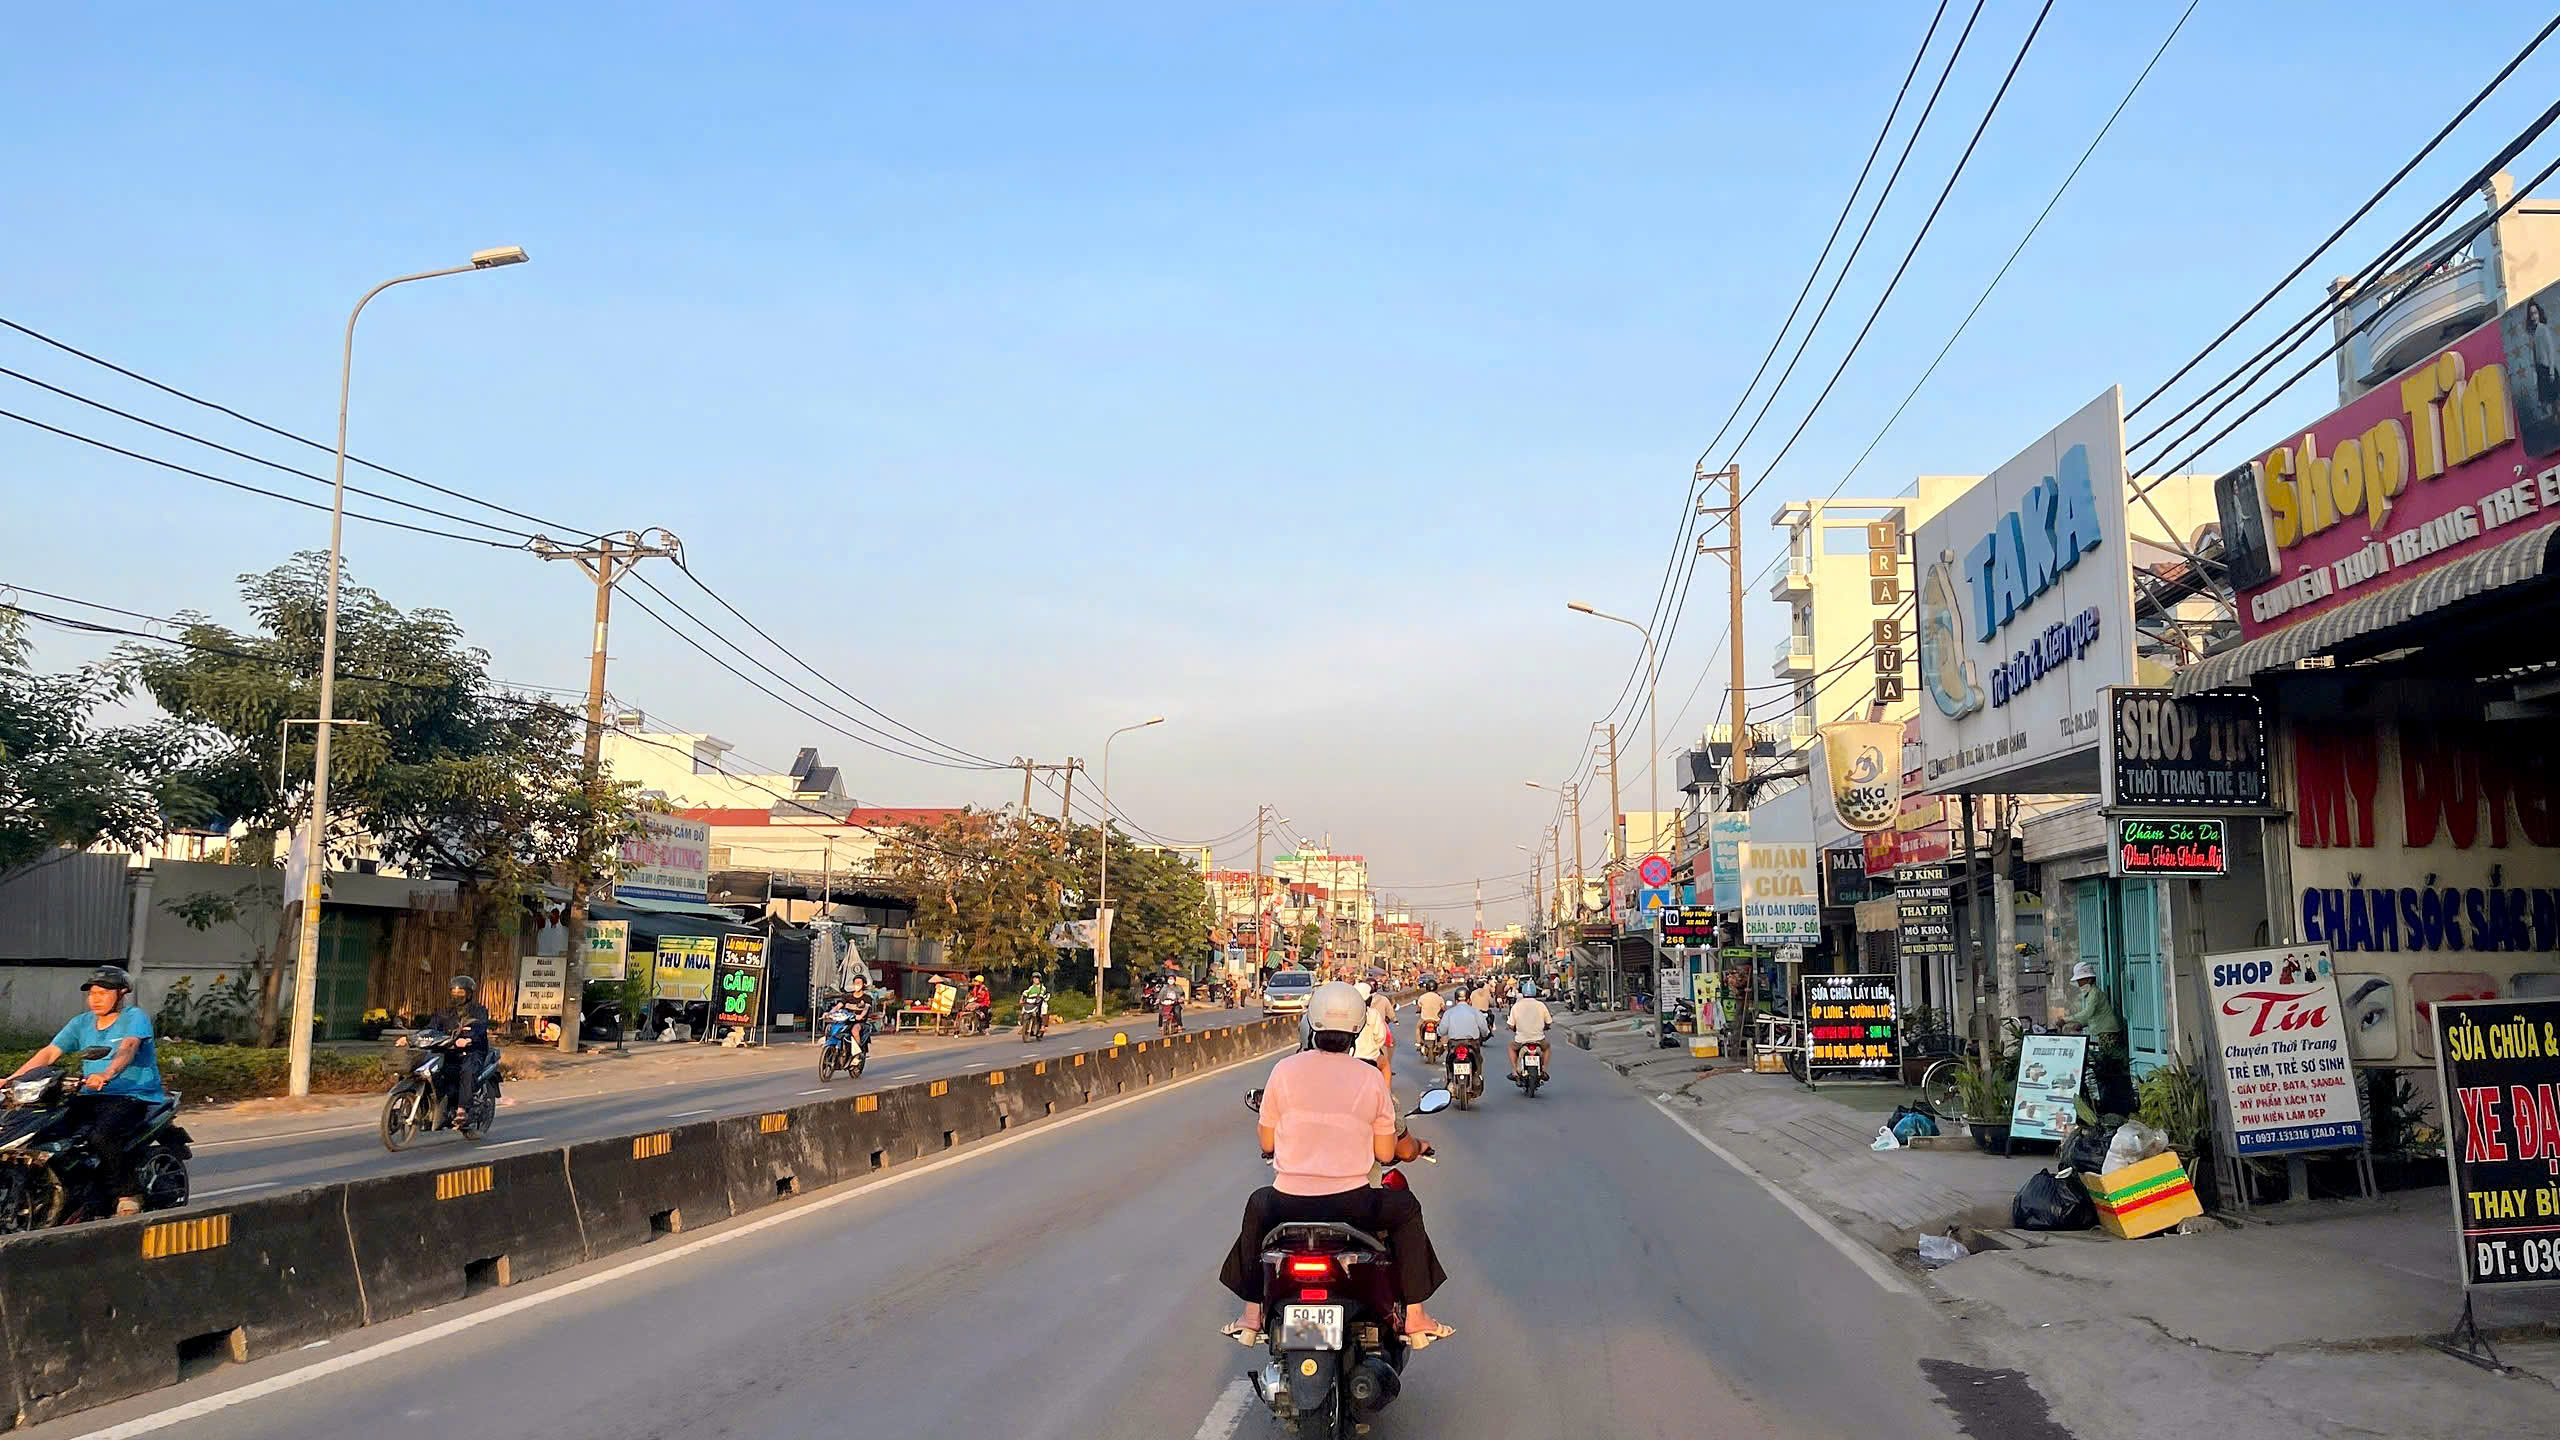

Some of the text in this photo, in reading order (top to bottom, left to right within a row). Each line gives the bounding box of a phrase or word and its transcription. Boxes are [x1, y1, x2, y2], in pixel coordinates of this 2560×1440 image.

[2264, 351, 2515, 548] Shop Tin
[2387, 505, 2481, 567] TRANG
[2477, 464, 2540, 530] TRẺ
[2537, 463, 2560, 508] E
[1964, 443, 2103, 643] TAKA
[1878, 526, 1898, 698] TRÀ SỮA
[2070, 606, 2100, 662] que
[2121, 699, 2199, 761] SHOP
[2127, 761, 2259, 796] THỜI TRANG TRẺ EM
[2125, 822, 2219, 842] Chăm Sóc Da
[1756, 869, 1805, 897] CỬA
[1901, 905, 1948, 917] THAY PIN
[2302, 872, 2398, 952] CHĂM
[2400, 872, 2465, 952] SÓC
[2467, 863, 2530, 952] SẮC
[1666, 936, 1685, 944] 268
[659, 952, 682, 968] THU
[684, 953, 711, 970] MUA
[724, 950, 739, 964] 3%
[745, 952, 760, 966] 5%
[723, 969, 756, 993] CẦM
[2213, 960, 2273, 988] SHOP
[724, 992, 748, 1014] ĐỒ
[1811, 983, 1828, 1000] SỬA
[1830, 984, 1852, 1000] CHỮA
[1853, 982, 1869, 1000] LẤY
[1811, 1002, 1822, 1019] ỐP
[1849, 1002, 1876, 1019] CƯỜNG
[1876, 1003, 1891, 1020] LỰC
[2222, 986, 2331, 1037] Tin
[2225, 1038, 2338, 1059] Chuyên Thời Trang
[2448, 1012, 2560, 1062] SỬA CHỮA &
[2228, 1057, 2345, 1080] TRẺ EM, TRẺ SƠ SINH
[2311, 1076, 2345, 1089] SANDAL
[2256, 1093, 2282, 1109] PHẨM
[2310, 1093, 2328, 1104] TAY
[2242, 1113, 2261, 1125] PHỤ
[2457, 1083, 2560, 1175] XE ĐẠ
[2468, 1188, 2528, 1220] THAY
[2478, 1240, 2518, 1276] ĐT:
